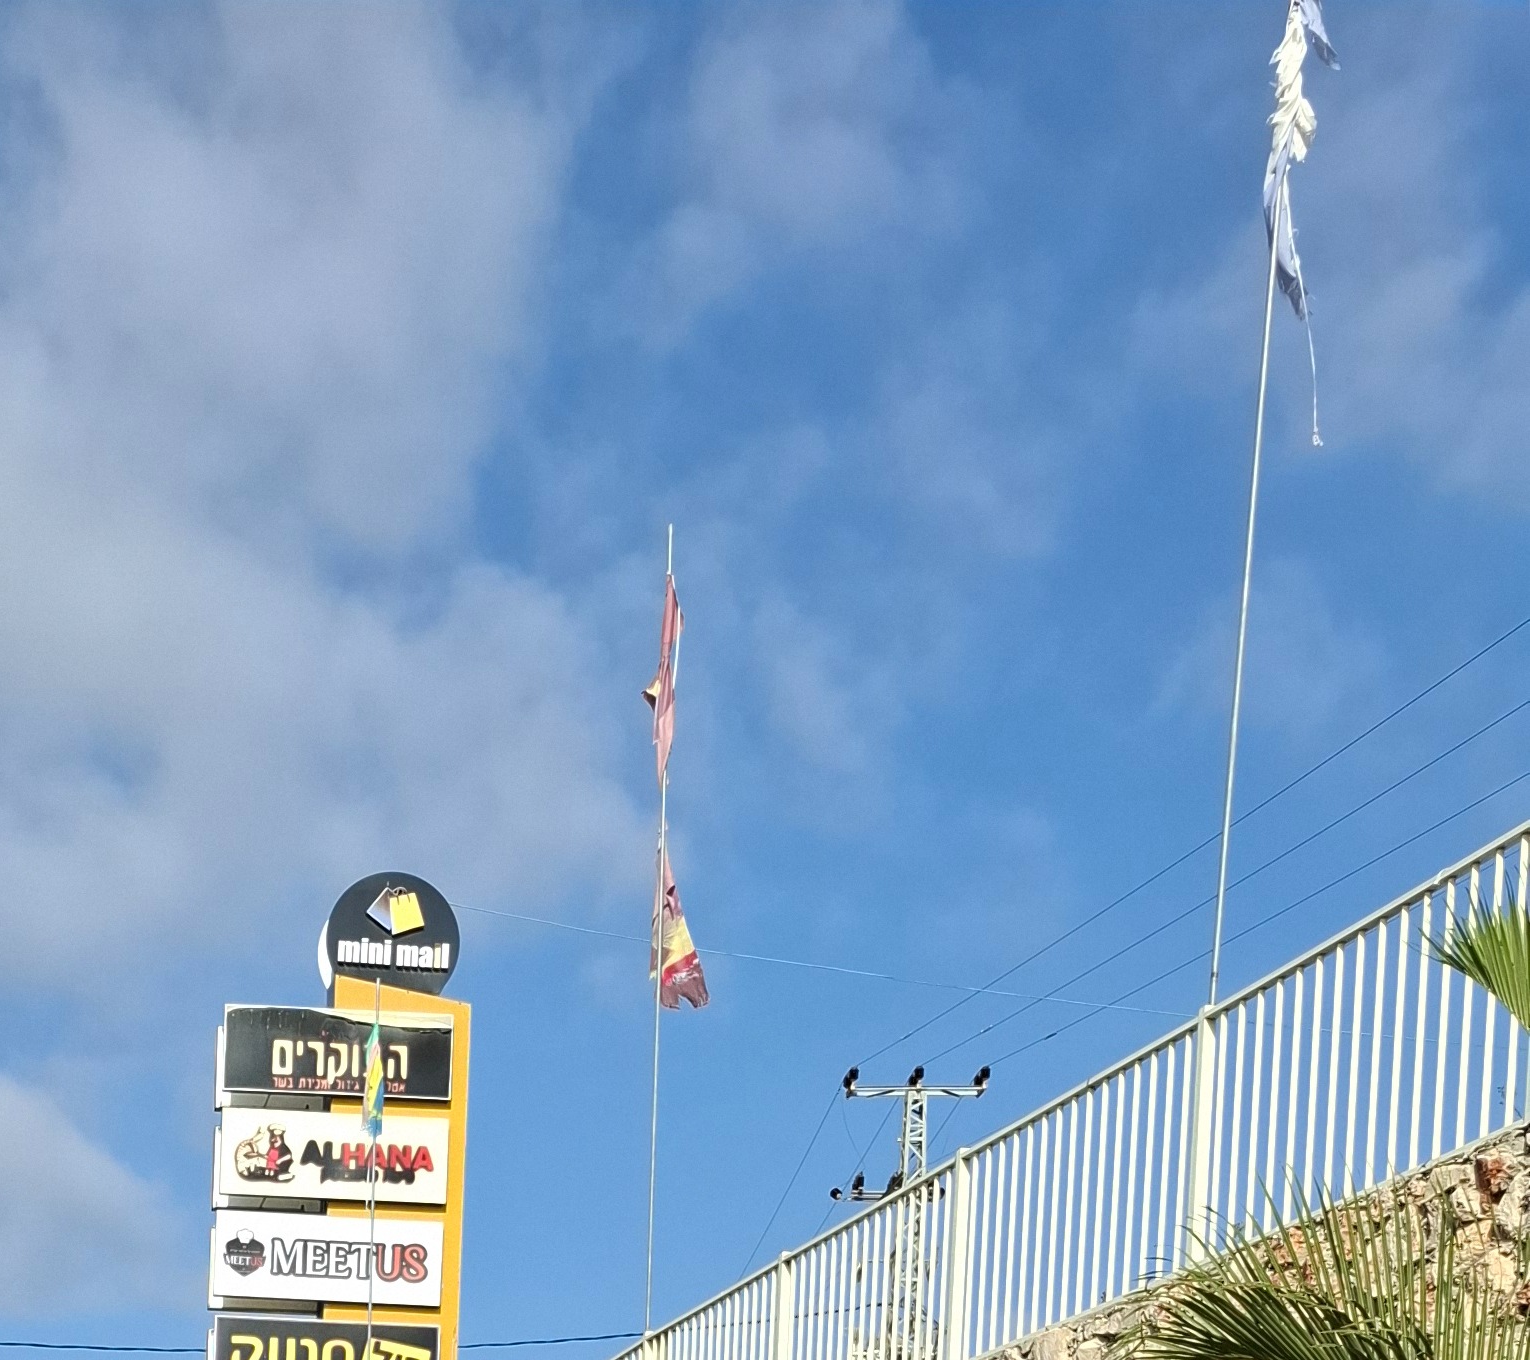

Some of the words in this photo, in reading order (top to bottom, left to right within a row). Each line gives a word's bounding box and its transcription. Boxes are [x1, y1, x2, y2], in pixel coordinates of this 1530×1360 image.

[337, 937, 392, 966] mini
[272, 1039, 408, 1085] הוקרים
[270, 1237, 428, 1283] MEETUS
